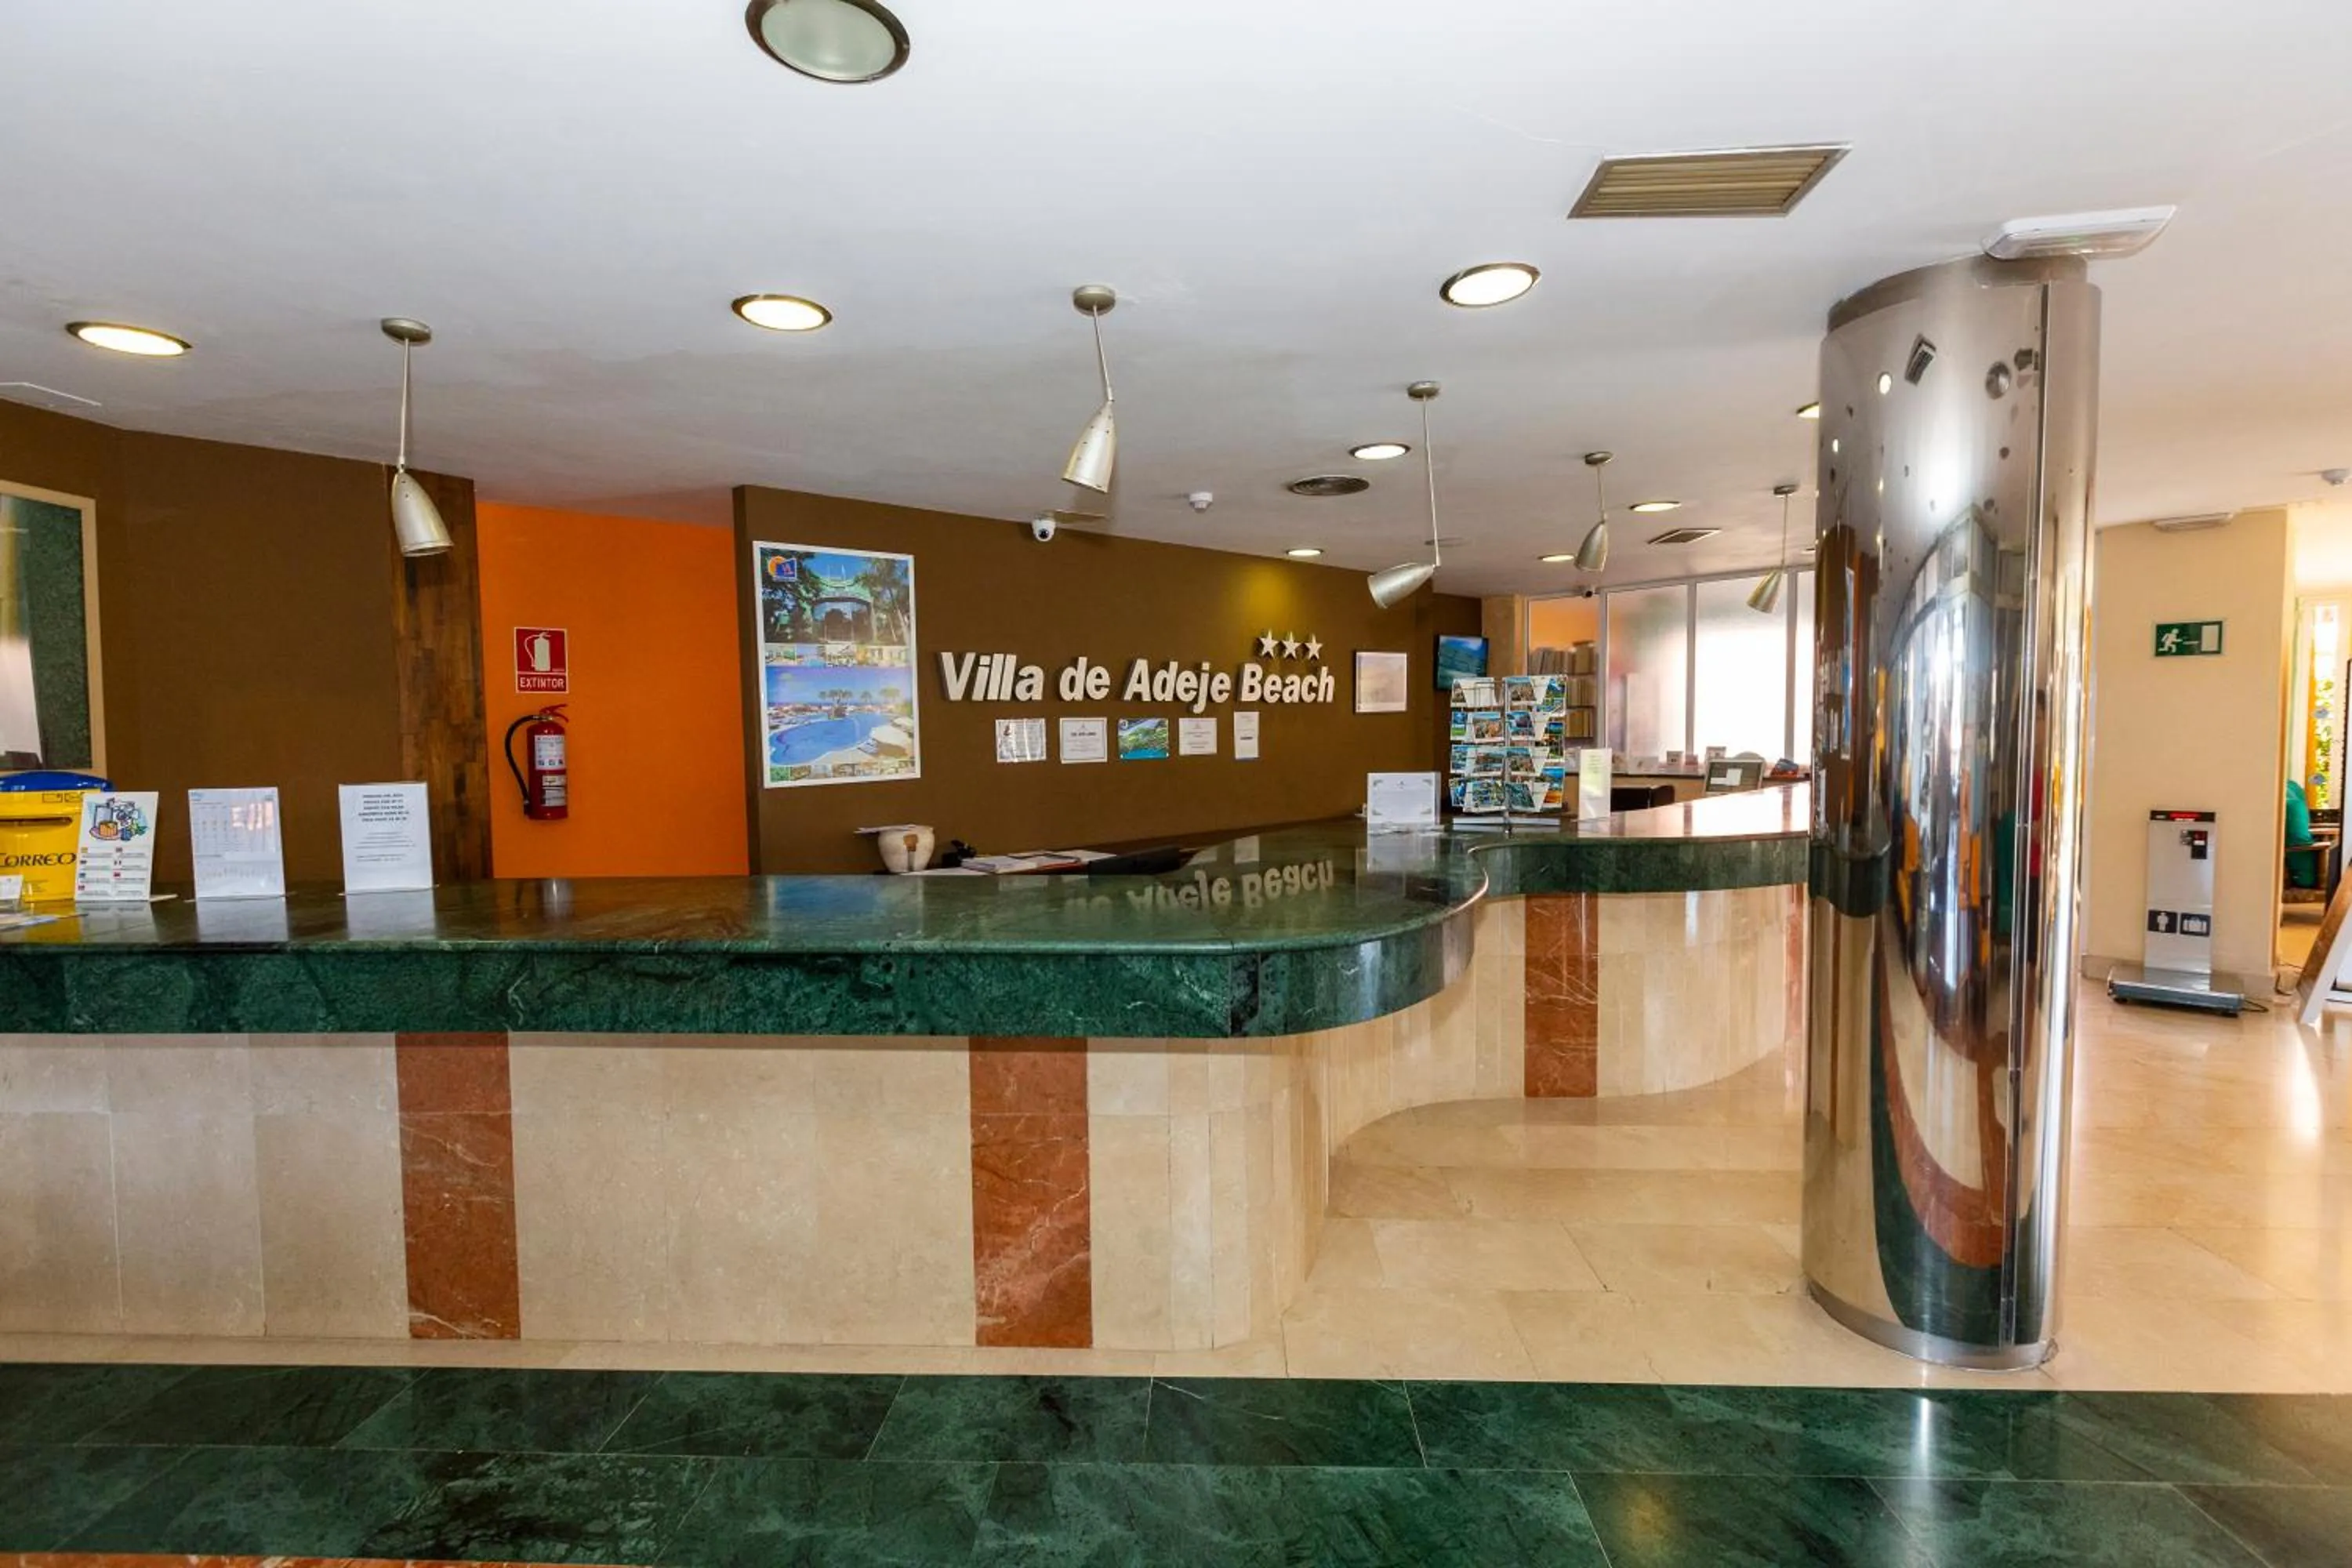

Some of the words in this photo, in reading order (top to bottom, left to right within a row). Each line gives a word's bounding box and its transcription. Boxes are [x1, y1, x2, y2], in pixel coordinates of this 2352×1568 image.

[519, 677, 565, 689] EXTINTOR
[941, 652, 1044, 702] Villa
[1059, 656, 1110, 702] de
[1123, 659, 1232, 714] Adeje
[1240, 662, 1335, 704] Beach
